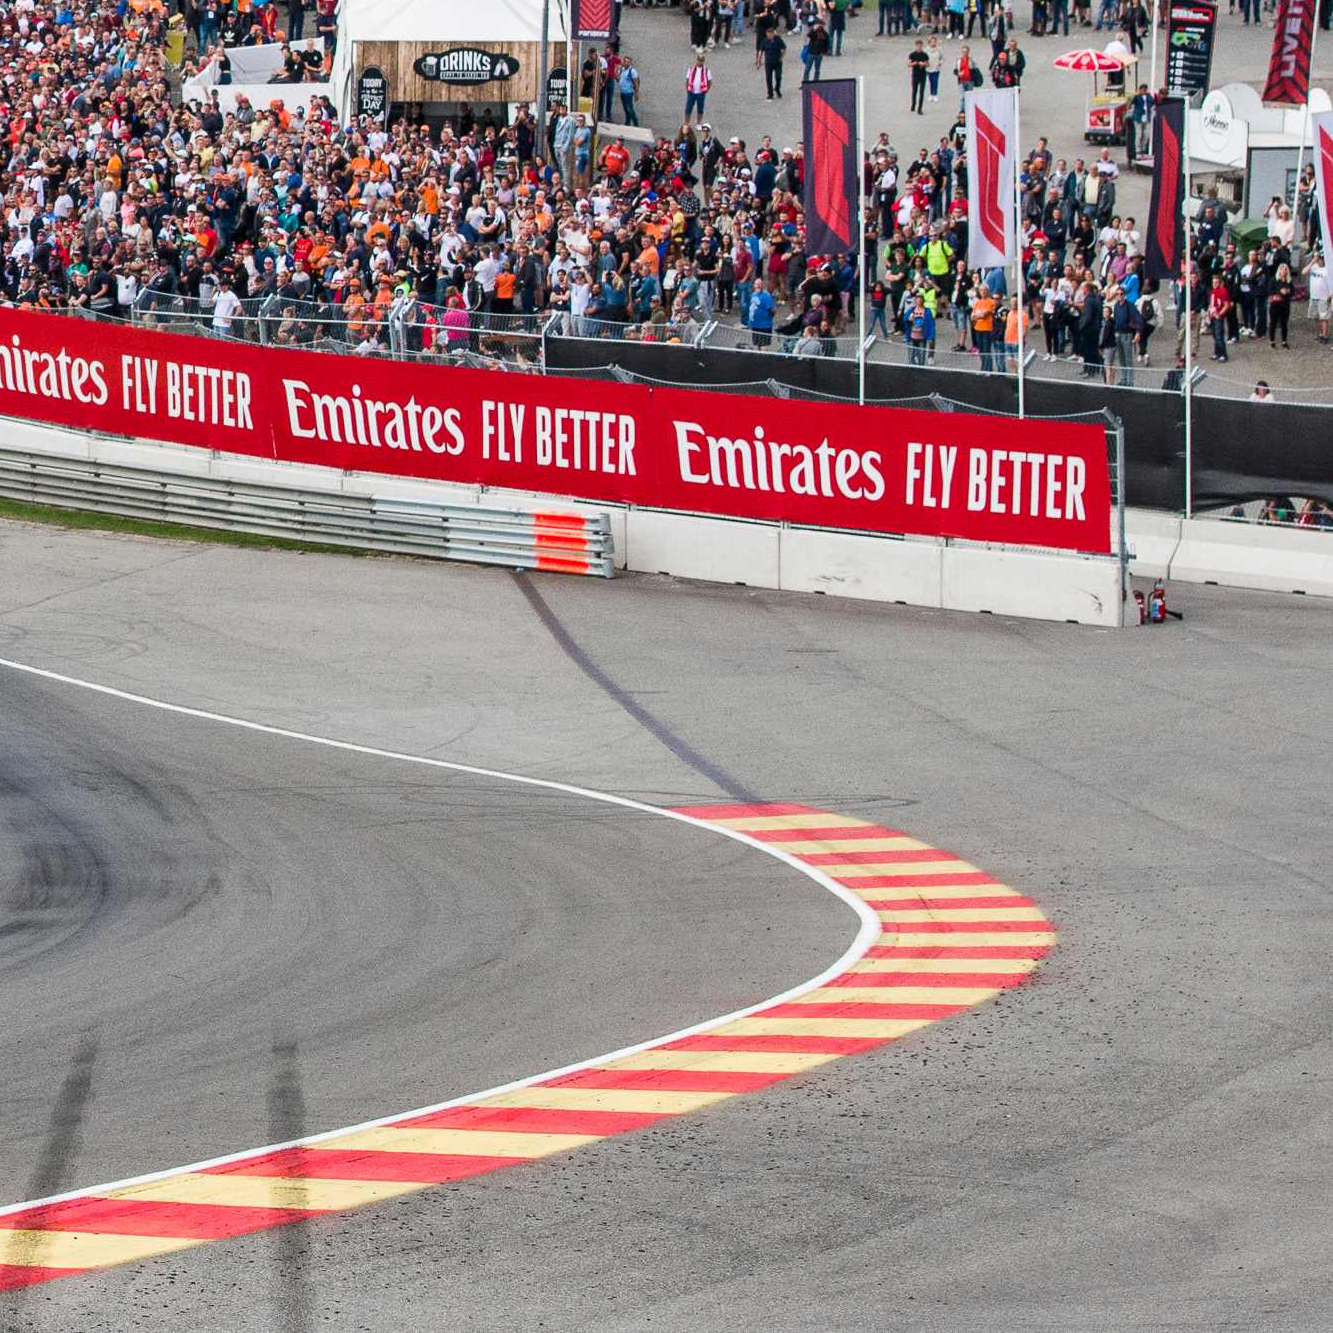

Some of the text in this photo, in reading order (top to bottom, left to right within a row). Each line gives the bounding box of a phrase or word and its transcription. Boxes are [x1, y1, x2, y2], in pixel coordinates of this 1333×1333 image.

[363, 78, 383, 88] TODAY
[440, 50, 491, 71] DRINKS
[363, 99, 381, 109] DAY
[121, 354, 159, 414] FLY
[166, 362, 255, 431] BETTER
[282, 378, 637, 476] Emirates FLY BETTER
[673, 419, 1087, 521] Emirates FLY BETTER
